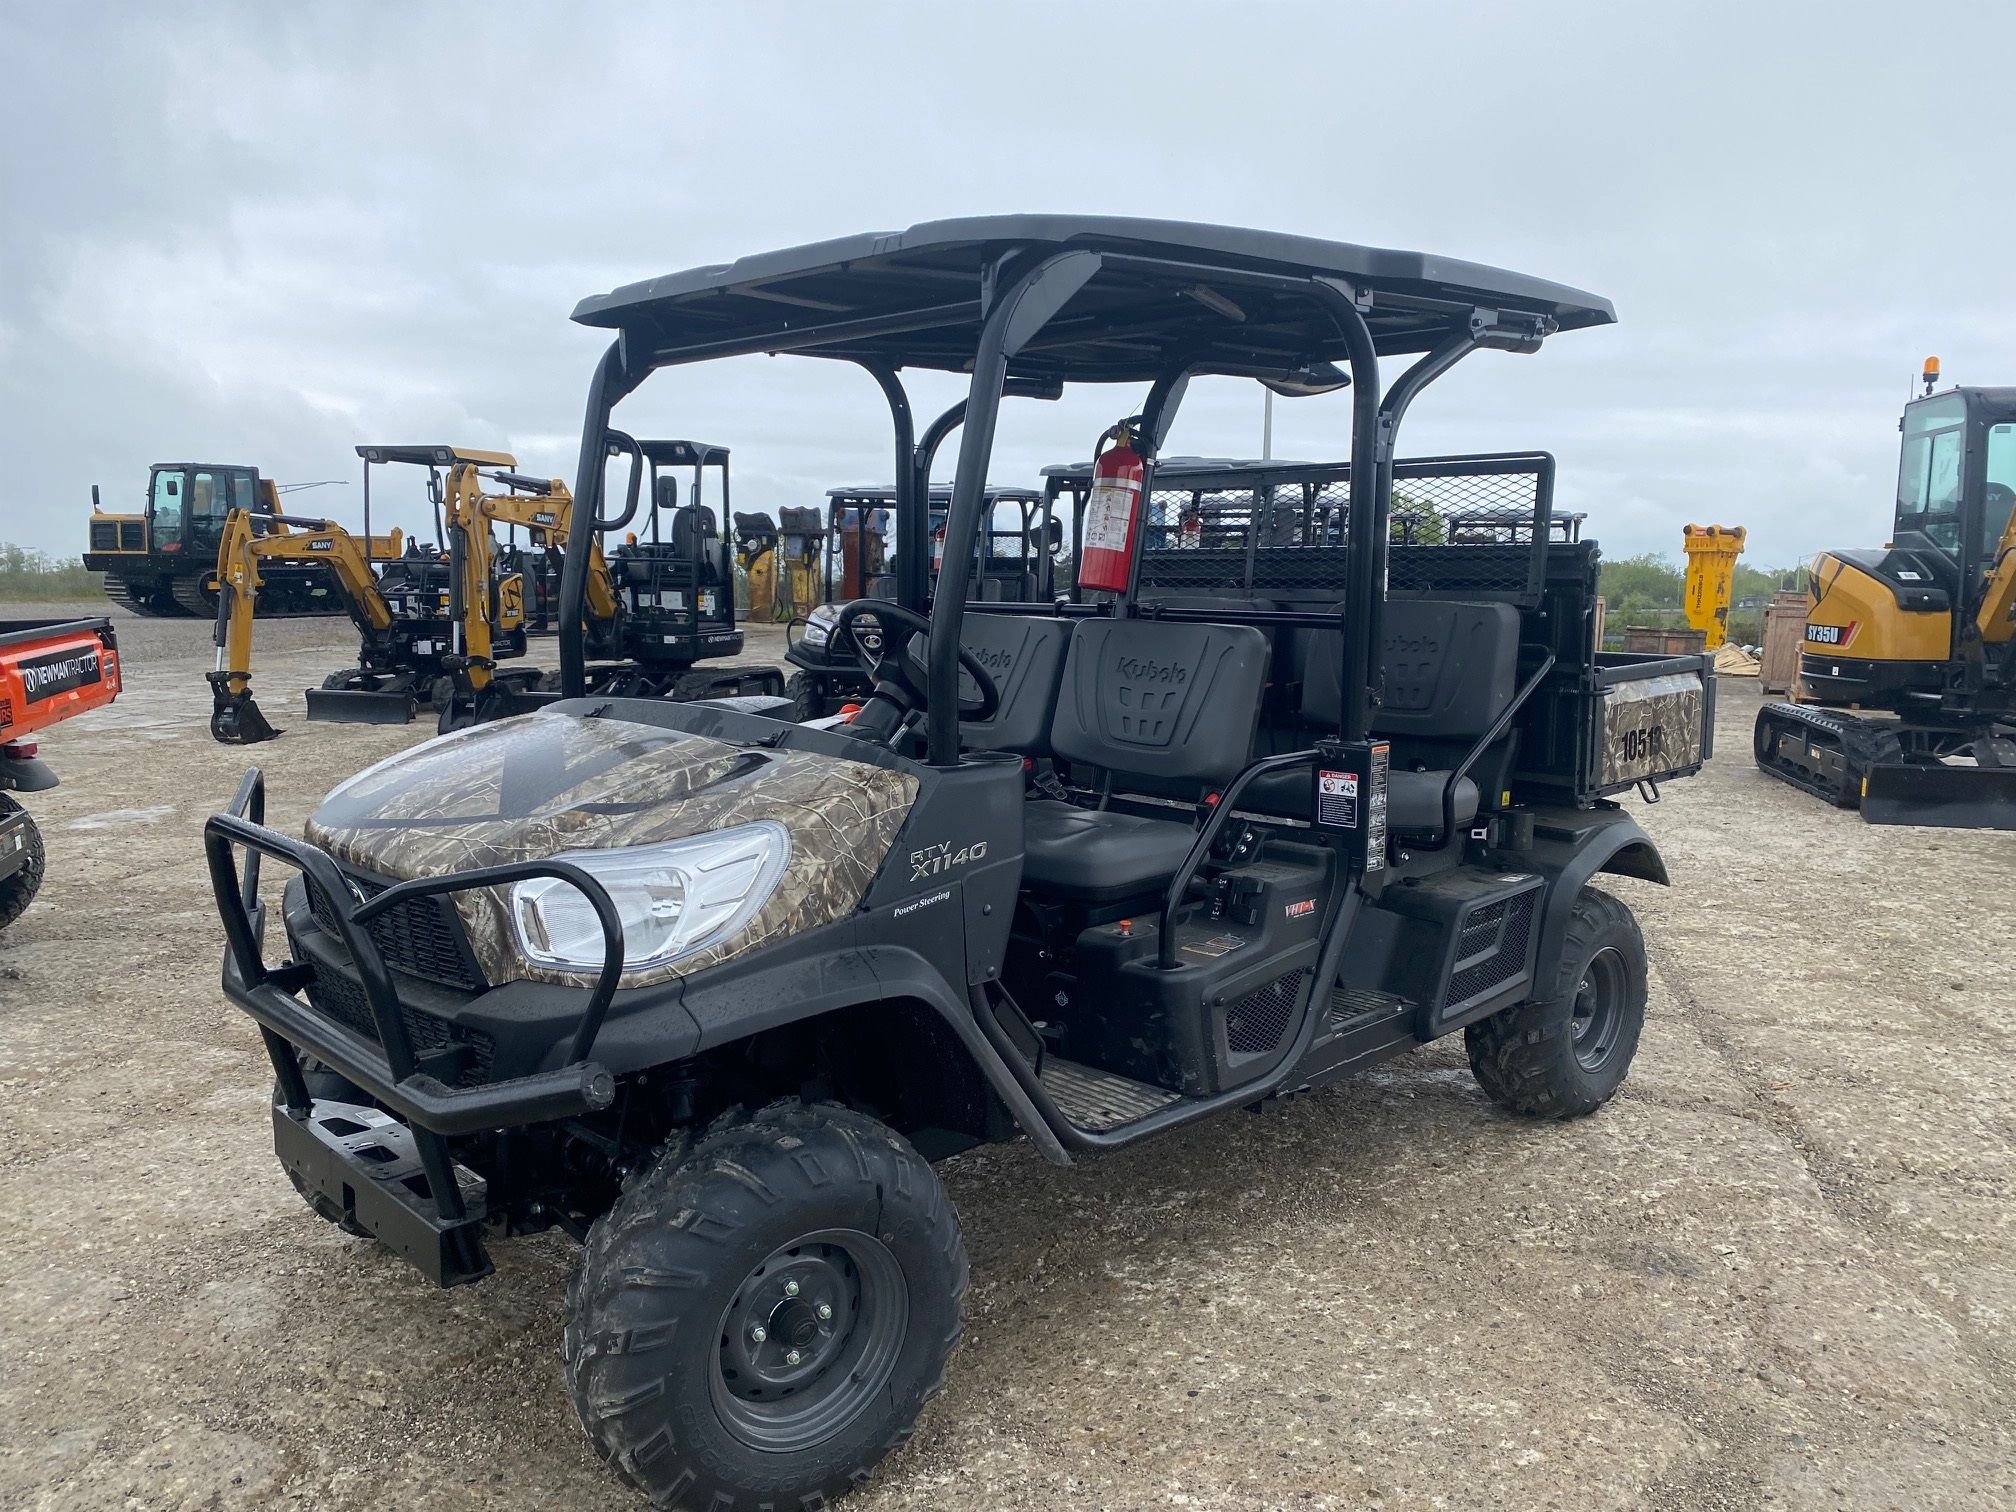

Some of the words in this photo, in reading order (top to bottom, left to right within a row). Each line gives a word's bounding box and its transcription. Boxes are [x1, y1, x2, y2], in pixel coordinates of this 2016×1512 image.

[536, 513, 554, 524] SANY
[311, 541, 331, 549] SANY
[1807, 625, 1839, 643] SY35U
[1116, 656, 1187, 684] Kubota
[909, 841, 988, 882] X1140
[911, 841, 951, 864] RTV
[893, 902, 919, 918] Power
[919, 891, 951, 908] Steering
